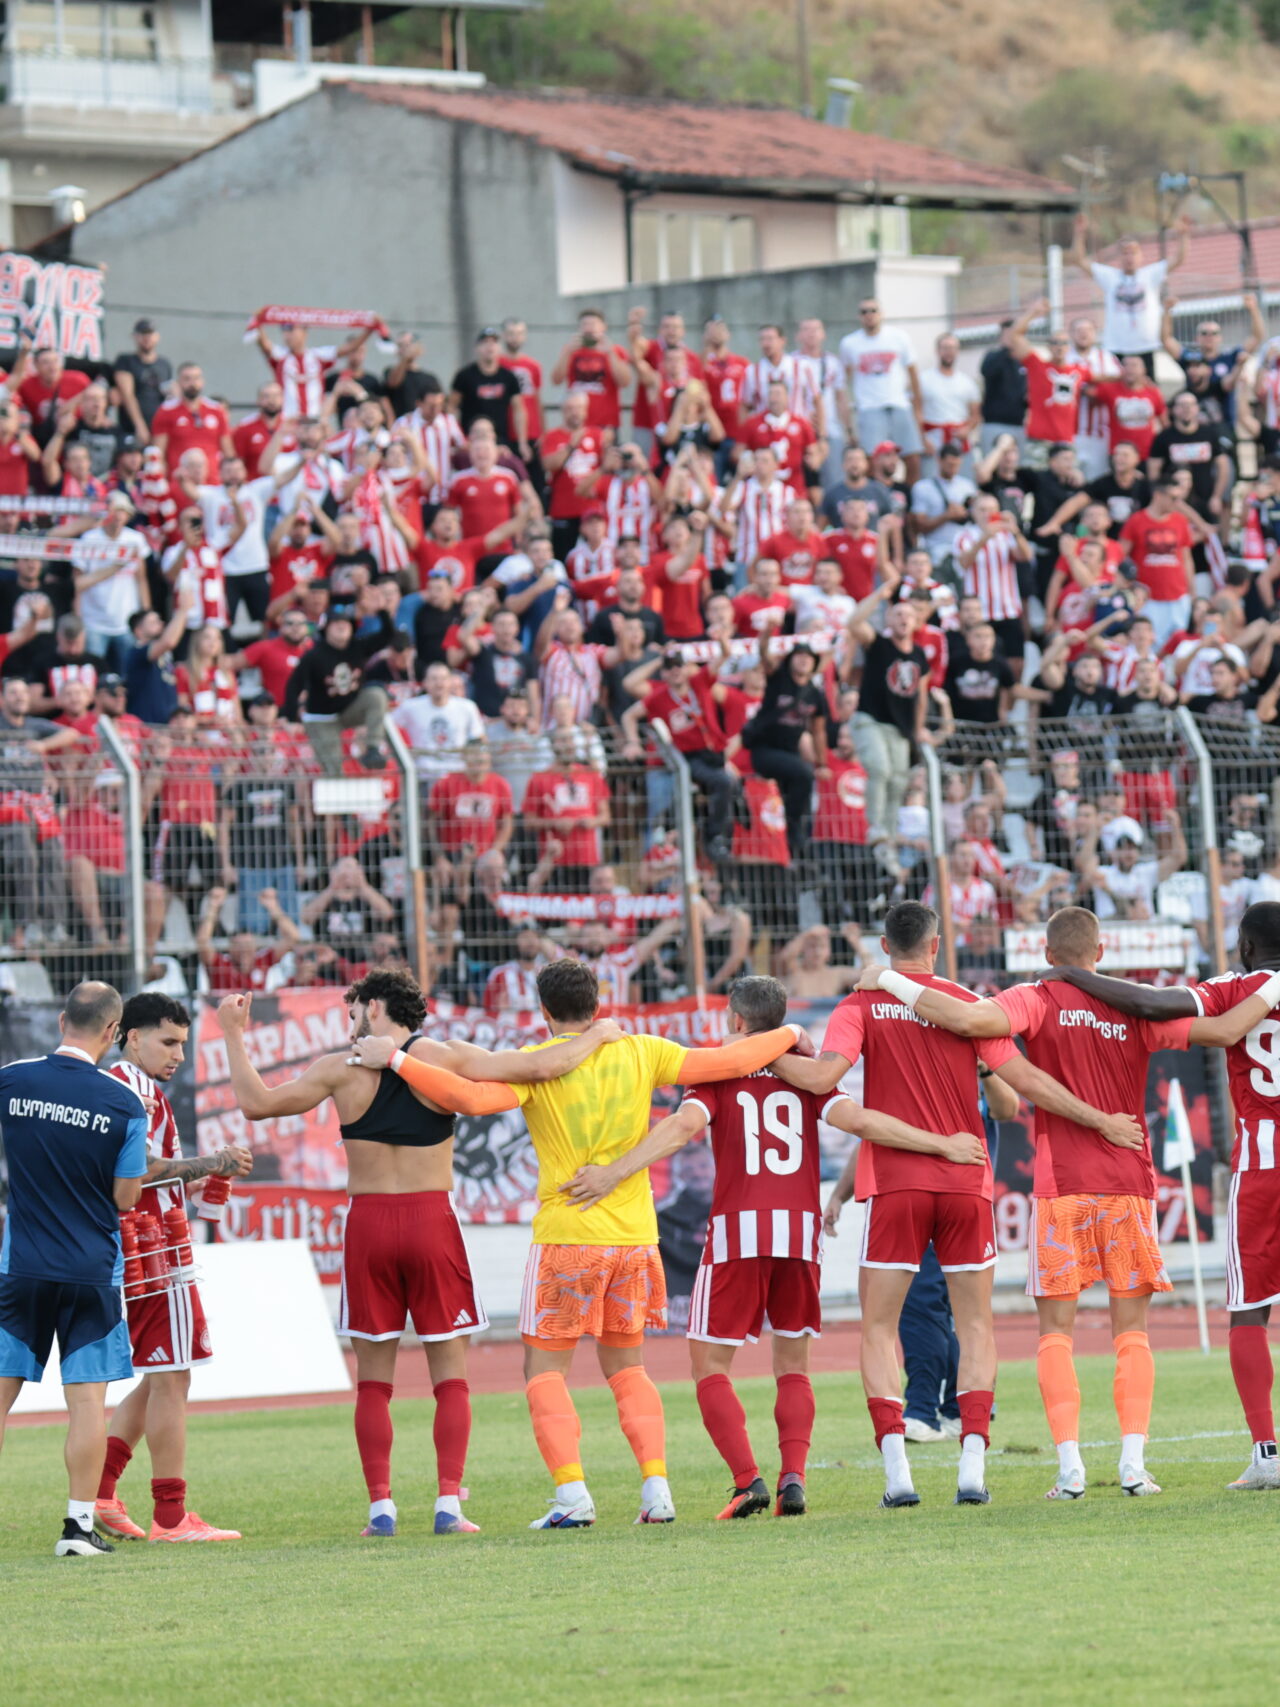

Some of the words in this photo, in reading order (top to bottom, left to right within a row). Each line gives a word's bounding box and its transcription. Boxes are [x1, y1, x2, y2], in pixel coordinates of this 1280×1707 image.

[1112, 1023, 1127, 1041] FC
[9, 1097, 90, 1128] OLYMPIACOS
[91, 1113, 111, 1134] FC
[736, 1091, 803, 1175] 19
